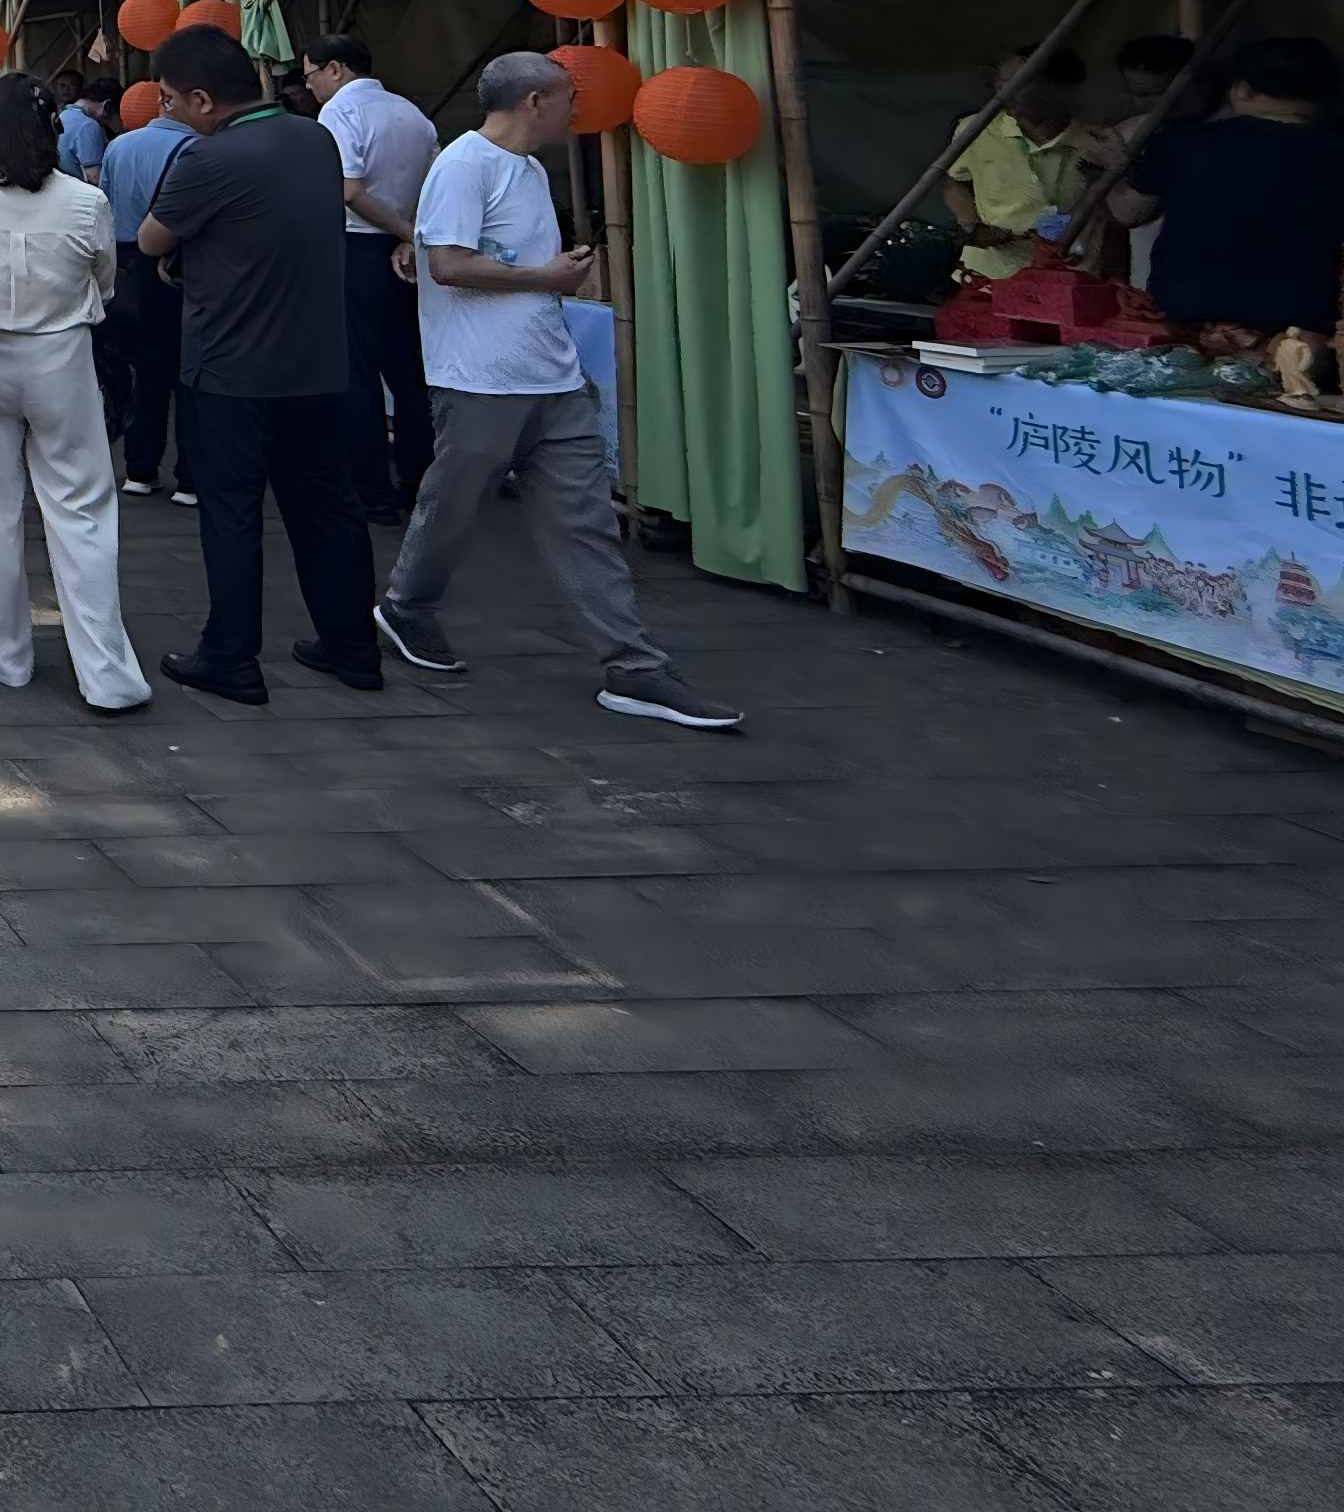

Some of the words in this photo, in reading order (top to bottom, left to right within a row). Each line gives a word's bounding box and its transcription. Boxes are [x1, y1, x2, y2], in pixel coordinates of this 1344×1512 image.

[989, 406, 1243, 498] “庐陵风物”
[1274, 471, 1344, 528] 非
